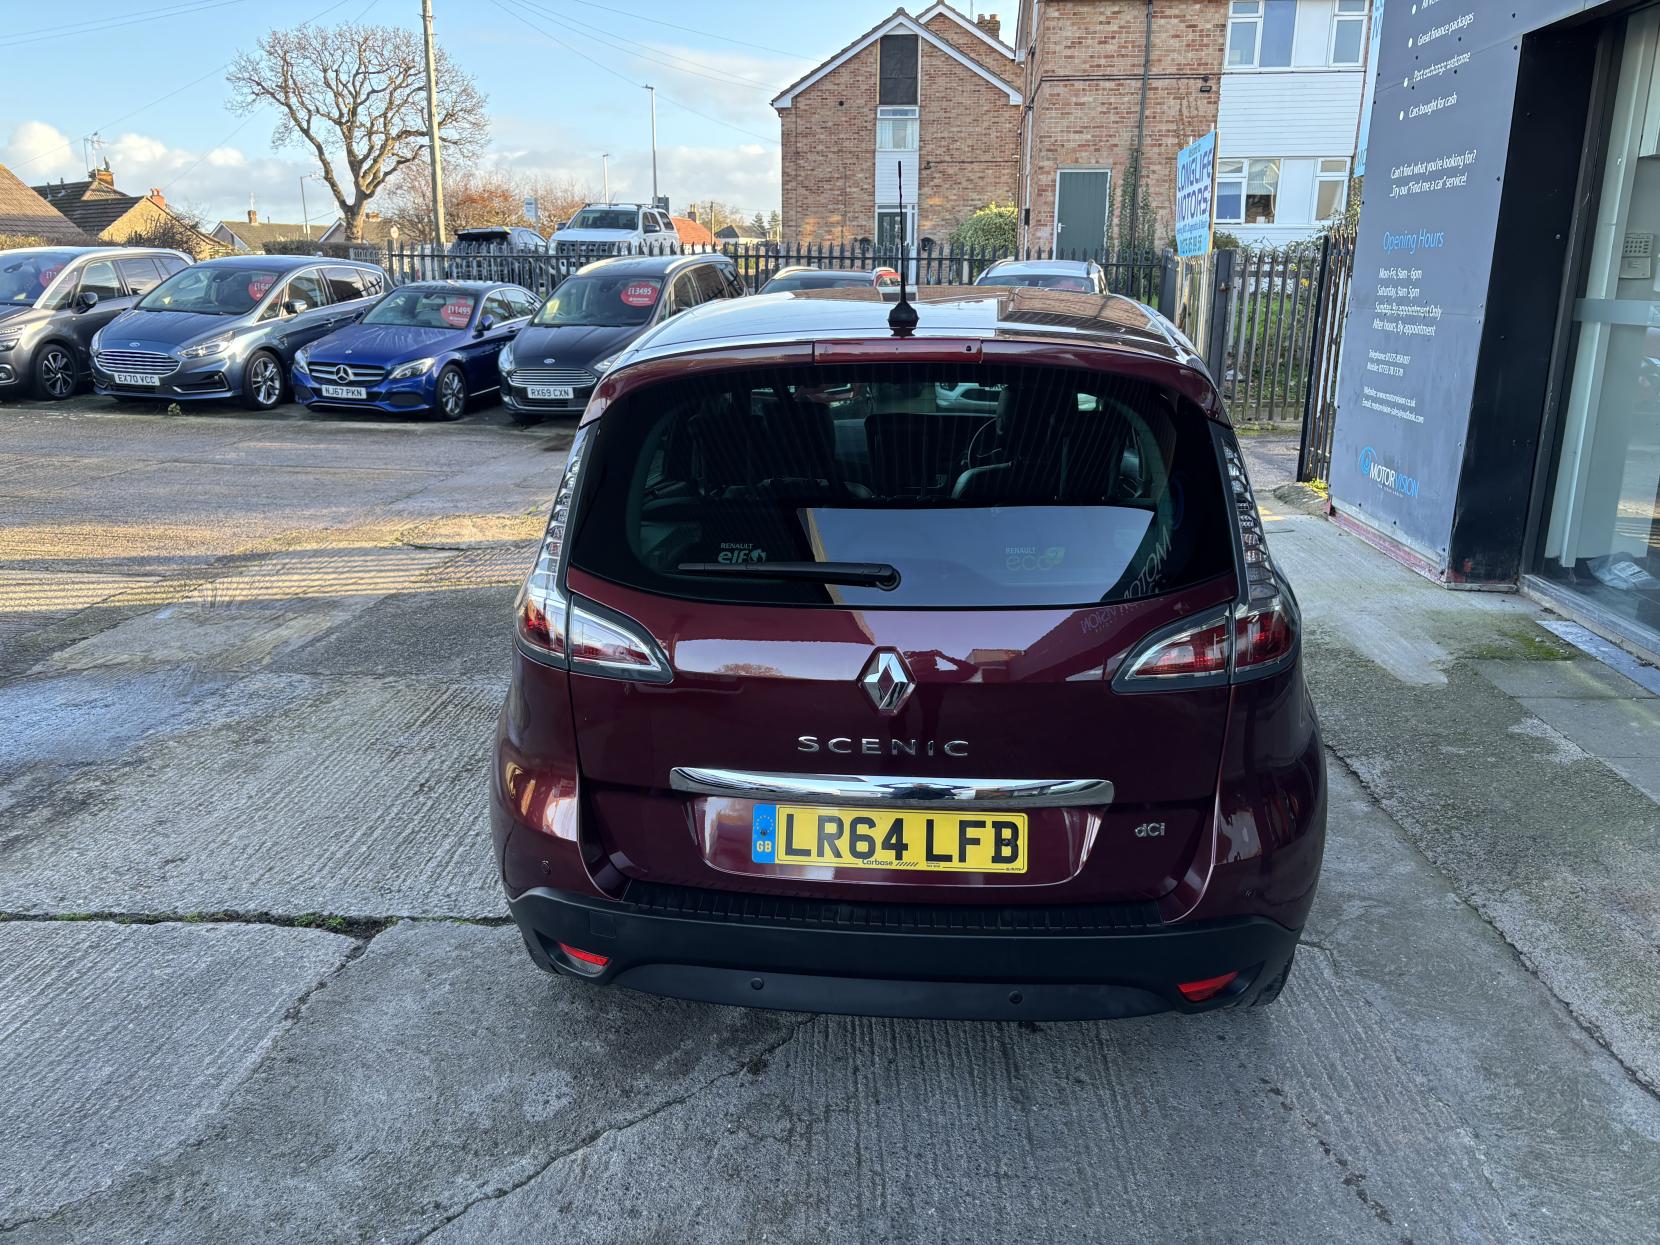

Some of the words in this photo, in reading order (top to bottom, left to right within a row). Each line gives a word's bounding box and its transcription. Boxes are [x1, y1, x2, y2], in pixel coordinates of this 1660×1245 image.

[1418, 32, 1431, 45] Great
[1431, 25, 1449, 40] finance
[1449, 12, 1474, 35] packages
[1413, 69, 1424, 82] Part
[1424, 62, 1446, 78] exchange
[1446, 52, 1471, 69] welcome
[1409, 106, 1419, 117] Cars
[1420, 98, 1437, 115] bought
[1445, 92, 1457, 107] cash
[1178, 147, 1212, 192] LONGLIFE
[1391, 167, 1403, 178] Can't
[1403, 163, 1414, 176] find
[1414, 161, 1426, 174] what
[1425, 157, 1442, 175] you're
[1443, 153, 1464, 168] looking
[1464, 149, 1476, 164] for?
[1400, 185, 1409, 195] our
[1422, 182, 1430, 191] me
[1446, 172, 1467, 188] service!
[1177, 185, 1209, 222] MOTORS
[1383, 230, 1417, 255] Opening
[1418, 229, 1445, 248] Hours
[1397, 268, 1408, 279] 9am
[1410, 268, 1422, 281] 6pm
[627, 287, 652, 295] £13495
[1397, 286, 1408, 297] 9am
[1408, 286, 1420, 299] 5pm
[1399, 304, 1430, 317] appointment
[1429, 305, 1442, 320] Only
[1372, 318, 1384, 330] After
[1397, 321, 1403, 335] By
[1404, 323, 1436, 336] appointment
[117, 374, 138, 383] EX70
[140, 375, 156, 384] VCC
[325, 387, 344, 396] NJ67
[346, 388, 362, 397] PKN
[553, 388, 569, 397] CXN
[1370, 462, 1420, 498] MOTORVISION
[718, 550, 749, 563] elf
[797, 736, 969, 756] SCENIC
[785, 813, 908, 861] LR64
[925, 818, 1020, 864] LFB
[1135, 822, 1165, 837] dCi
[756, 840, 772, 853] GB
[862, 859, 893, 867] Carbase
